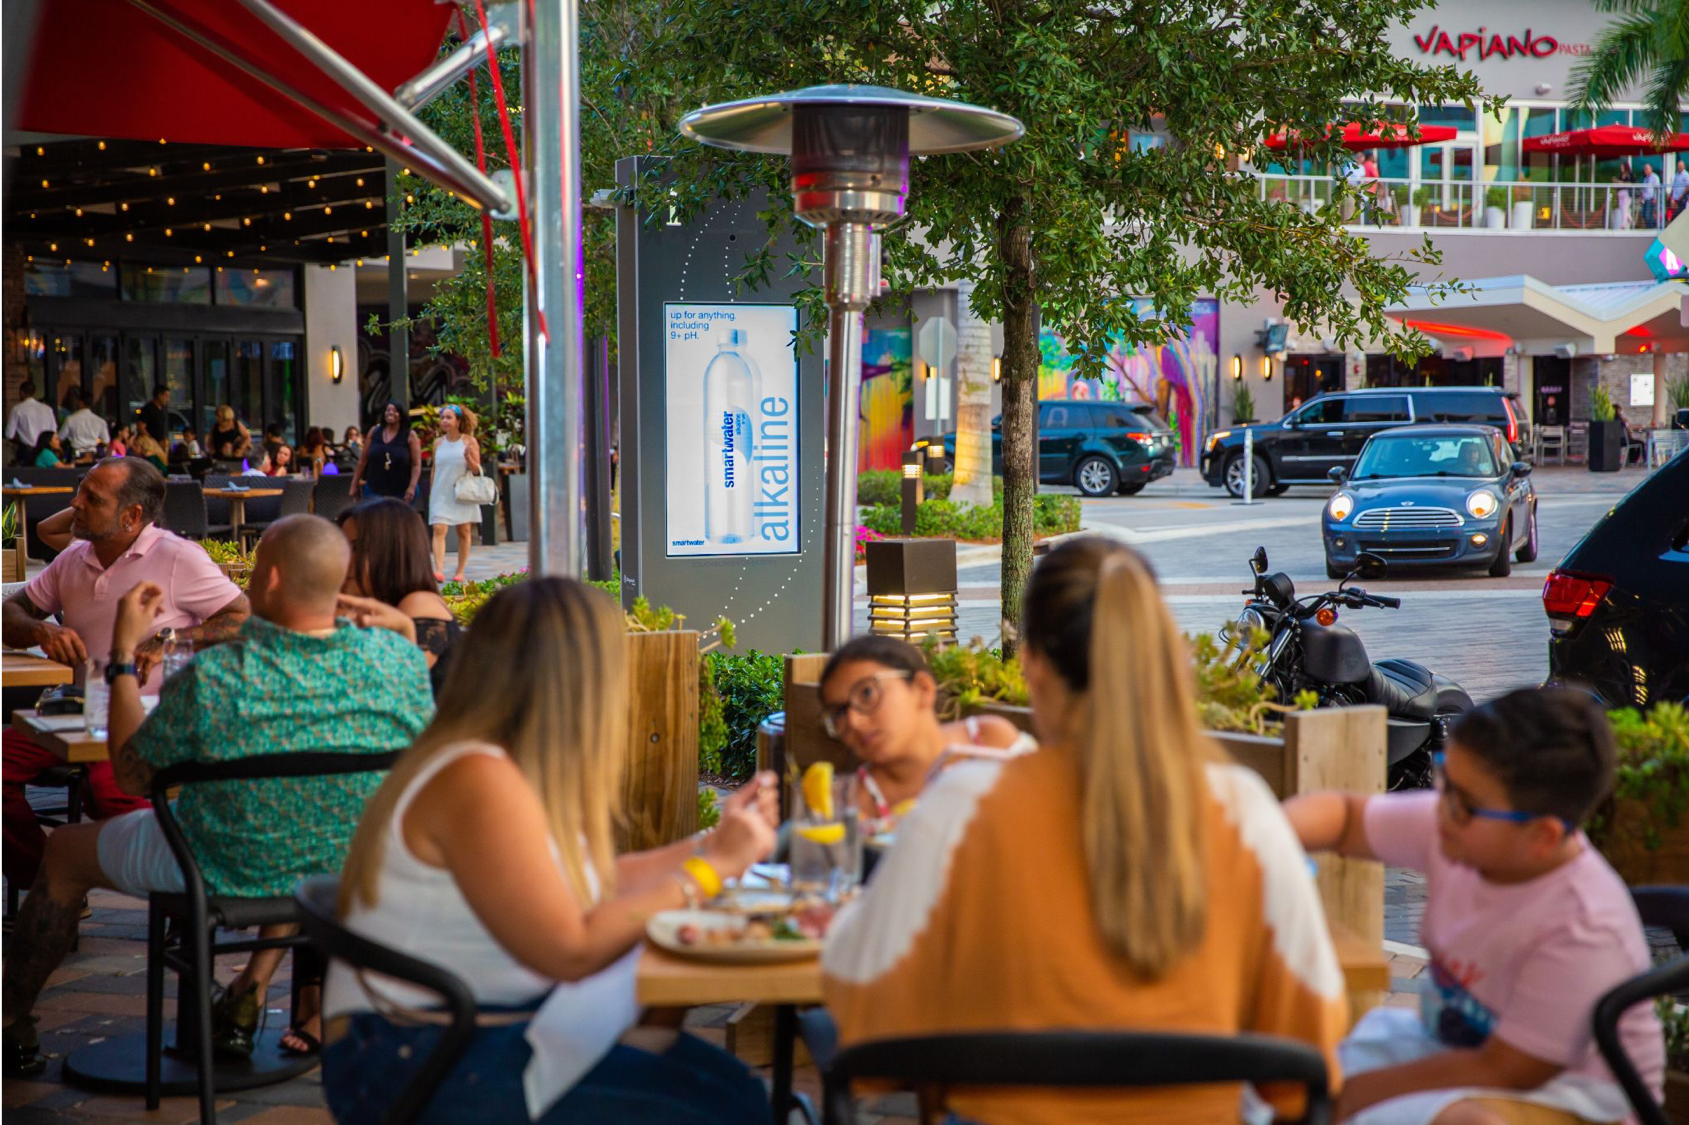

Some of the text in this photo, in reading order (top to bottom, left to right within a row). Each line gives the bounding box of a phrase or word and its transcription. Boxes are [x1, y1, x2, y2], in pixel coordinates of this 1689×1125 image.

[1558, 44, 1591, 56] PASTA
[670, 312, 682, 321] up
[684, 311, 696, 319] for
[670, 321, 709, 331] including
[670, 331, 681, 340] 9+
[721, 411, 734, 488] smartwater
[753, 396, 790, 541] alkaline
